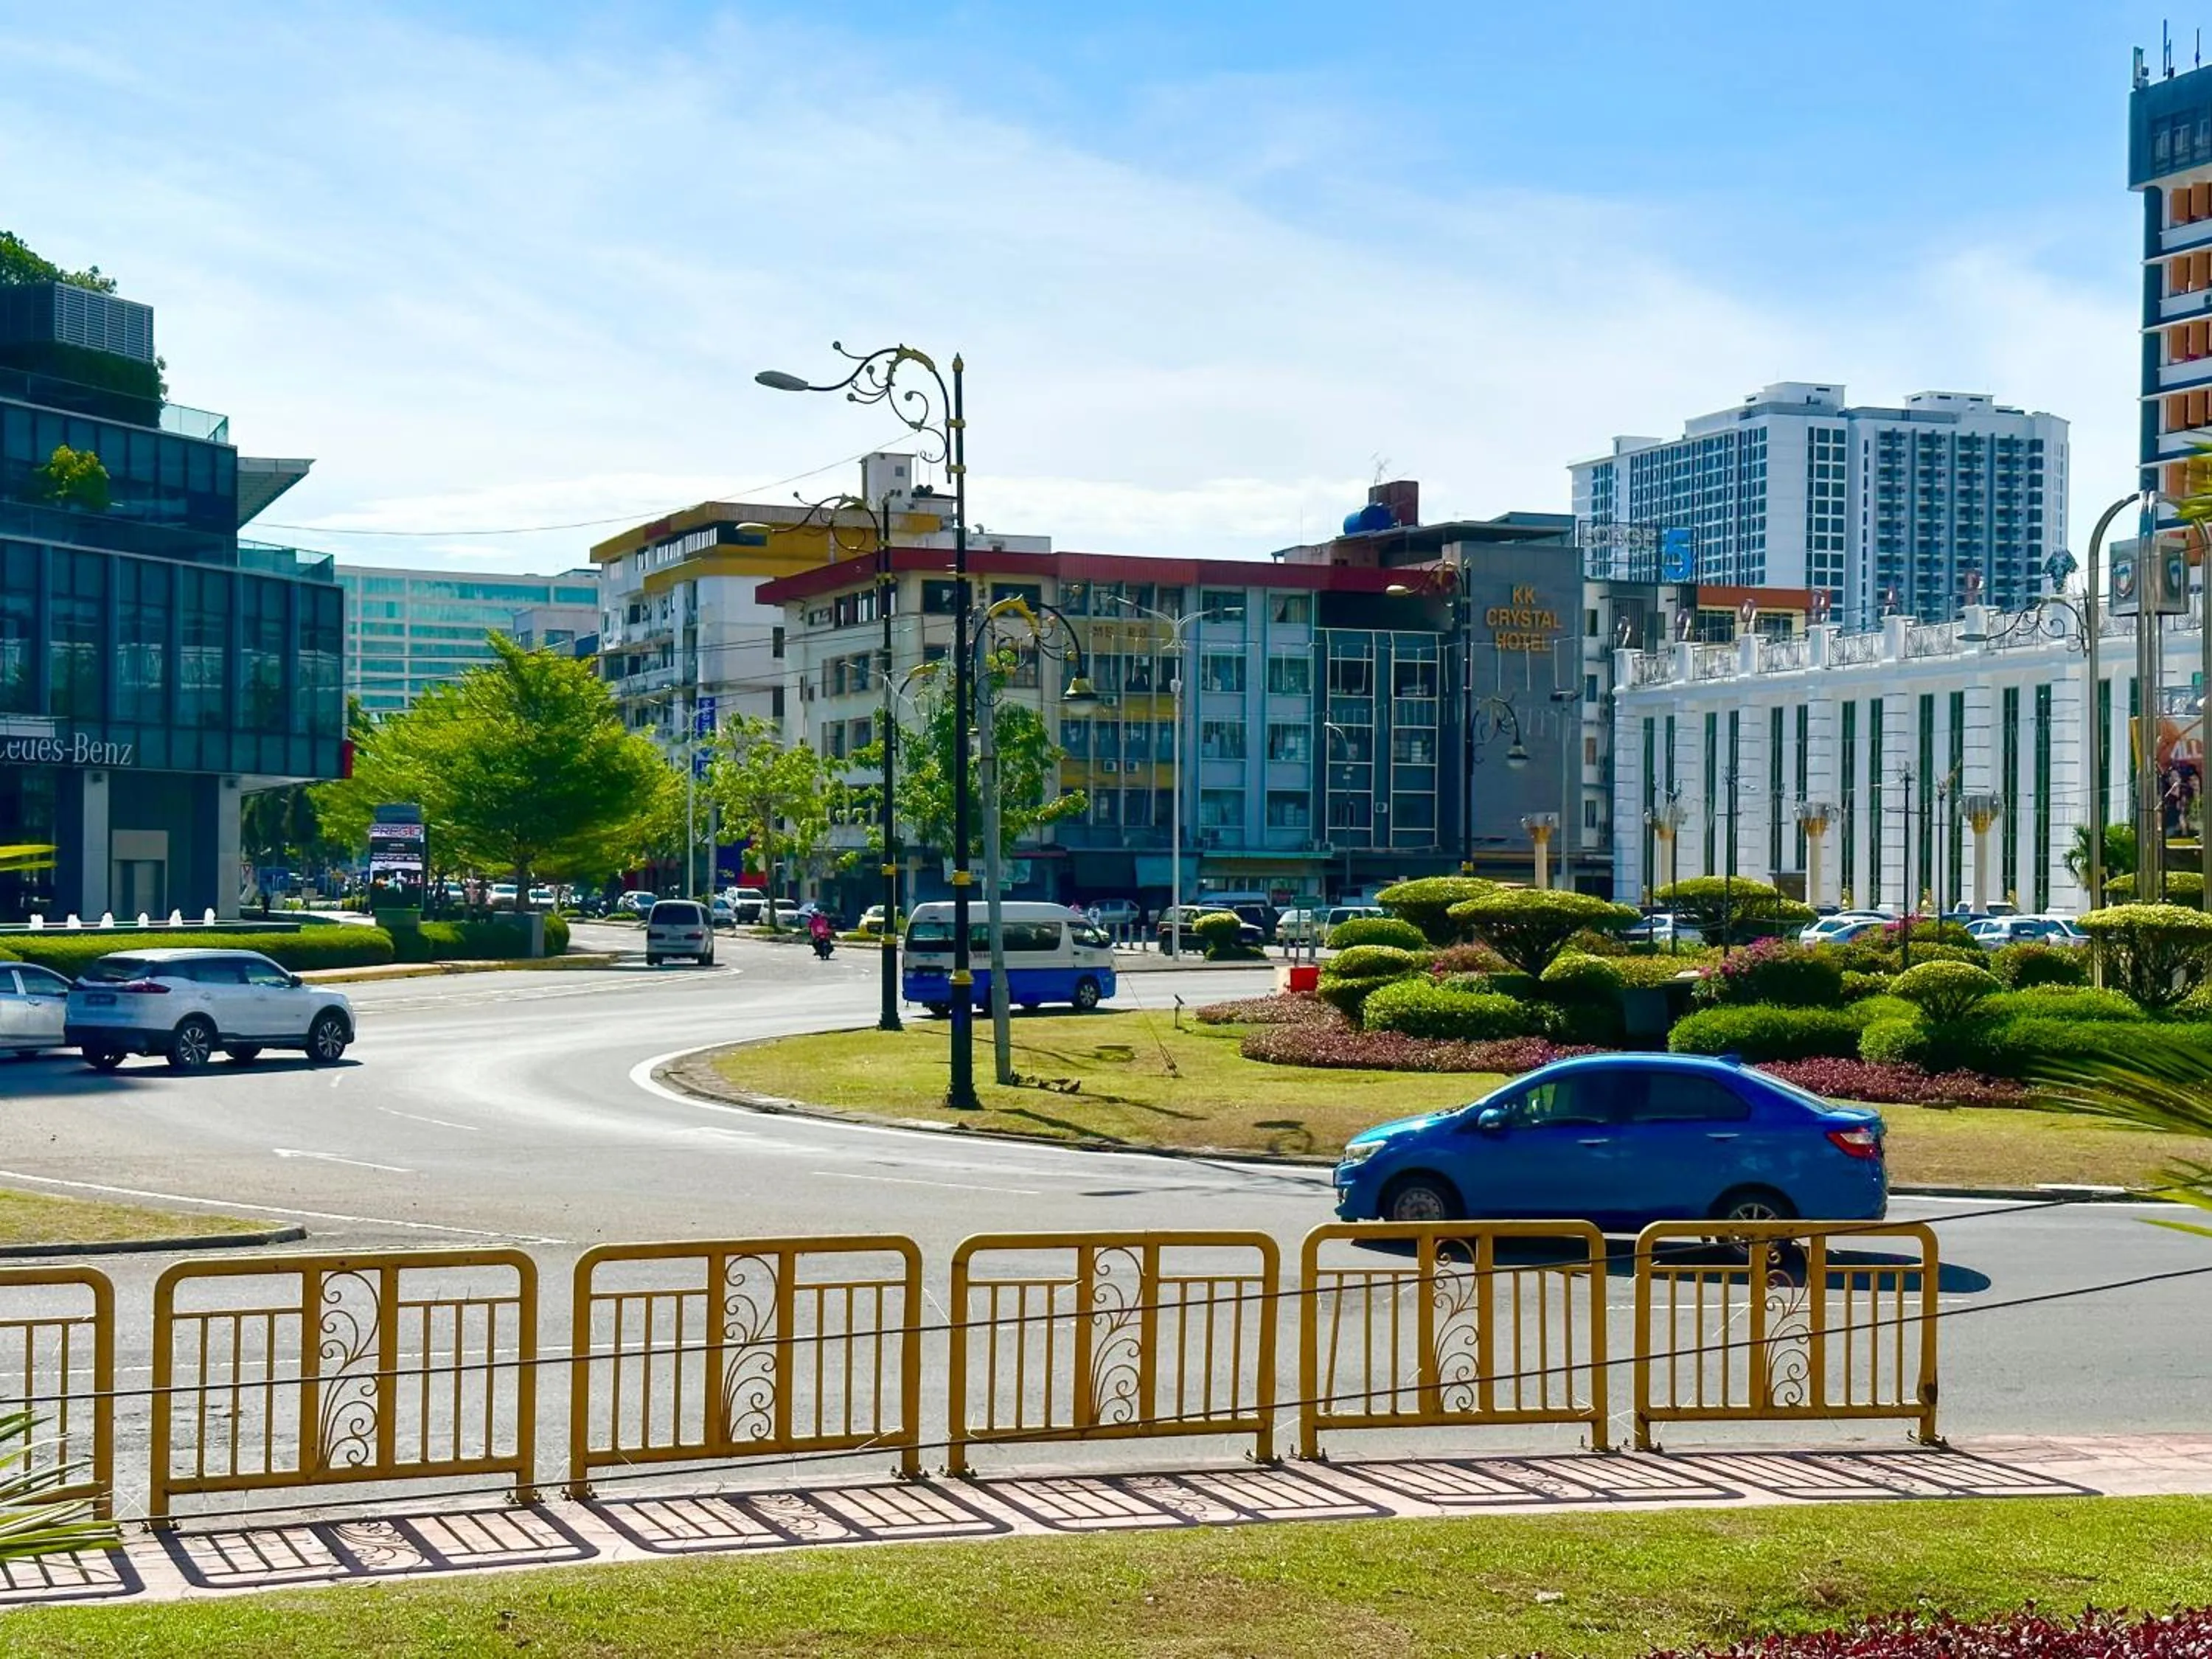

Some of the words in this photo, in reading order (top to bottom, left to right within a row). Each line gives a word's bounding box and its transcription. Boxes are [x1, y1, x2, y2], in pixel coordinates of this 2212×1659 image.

[1663, 526, 1694, 582] 5
[1512, 585, 1535, 605] KK
[1486, 608, 1562, 630] CRYSTAL
[1091, 625, 1147, 639] MERO
[1495, 632, 1551, 652] HOTEL
